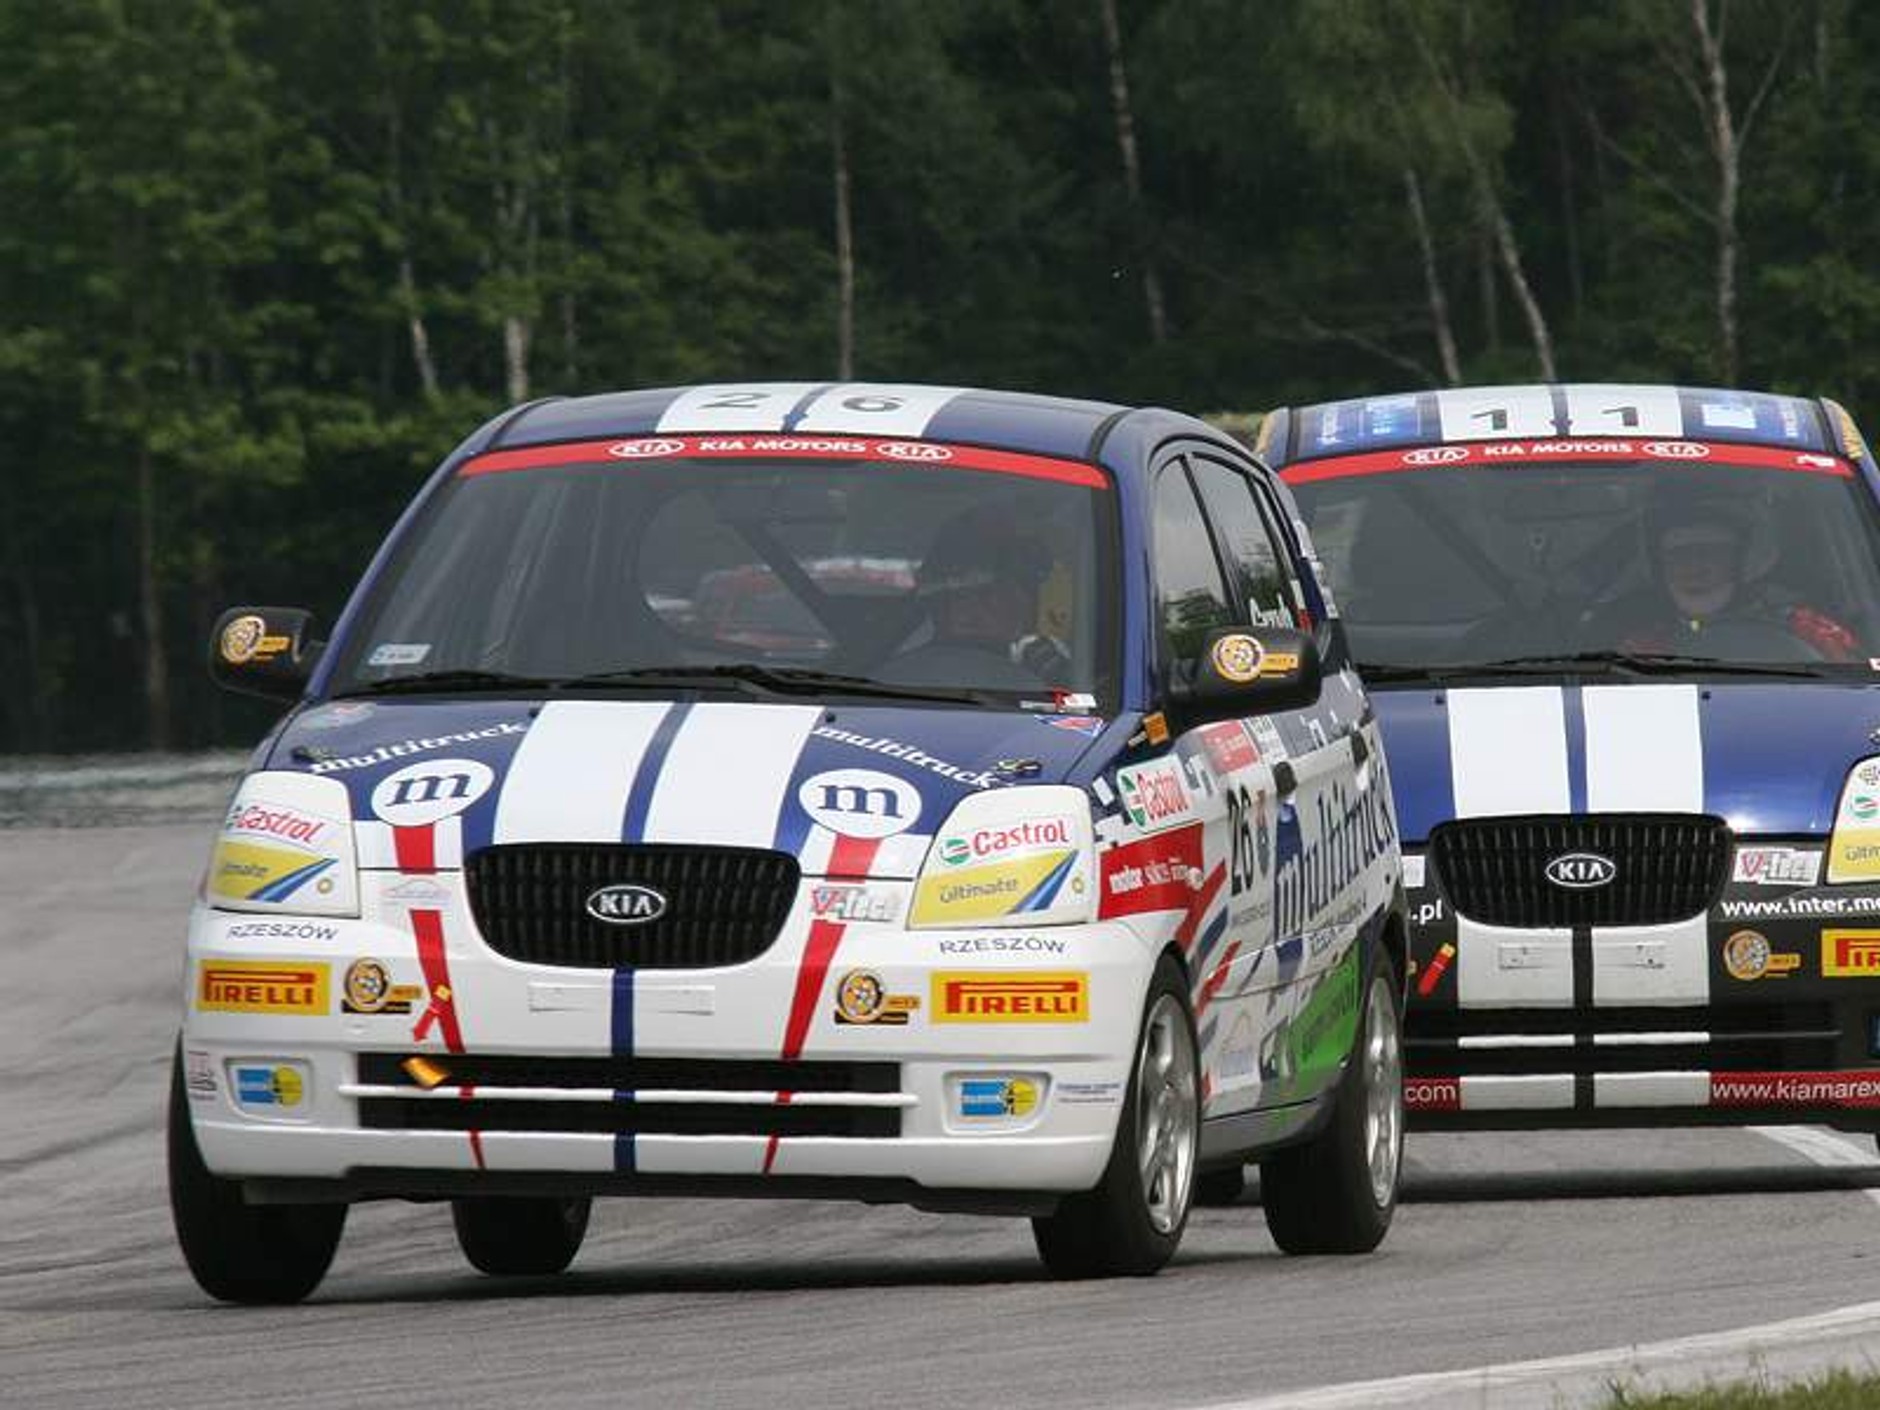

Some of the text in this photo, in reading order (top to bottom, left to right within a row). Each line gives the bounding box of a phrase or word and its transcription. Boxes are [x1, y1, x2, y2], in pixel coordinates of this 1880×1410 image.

[1471, 406, 1639, 431] 1 1
[700, 440, 745, 451] KIA
[752, 440, 867, 453] MOTORS
[1484, 445, 1525, 456] KIA
[1531, 442, 1633, 453] MOTORS
[236, 804, 326, 843] Castrol
[972, 820, 1069, 857] Castrol
[1227, 784, 1254, 897] 26
[203, 969, 315, 1005] PIRELLI
[945, 981, 1079, 1014] PIRELLI
